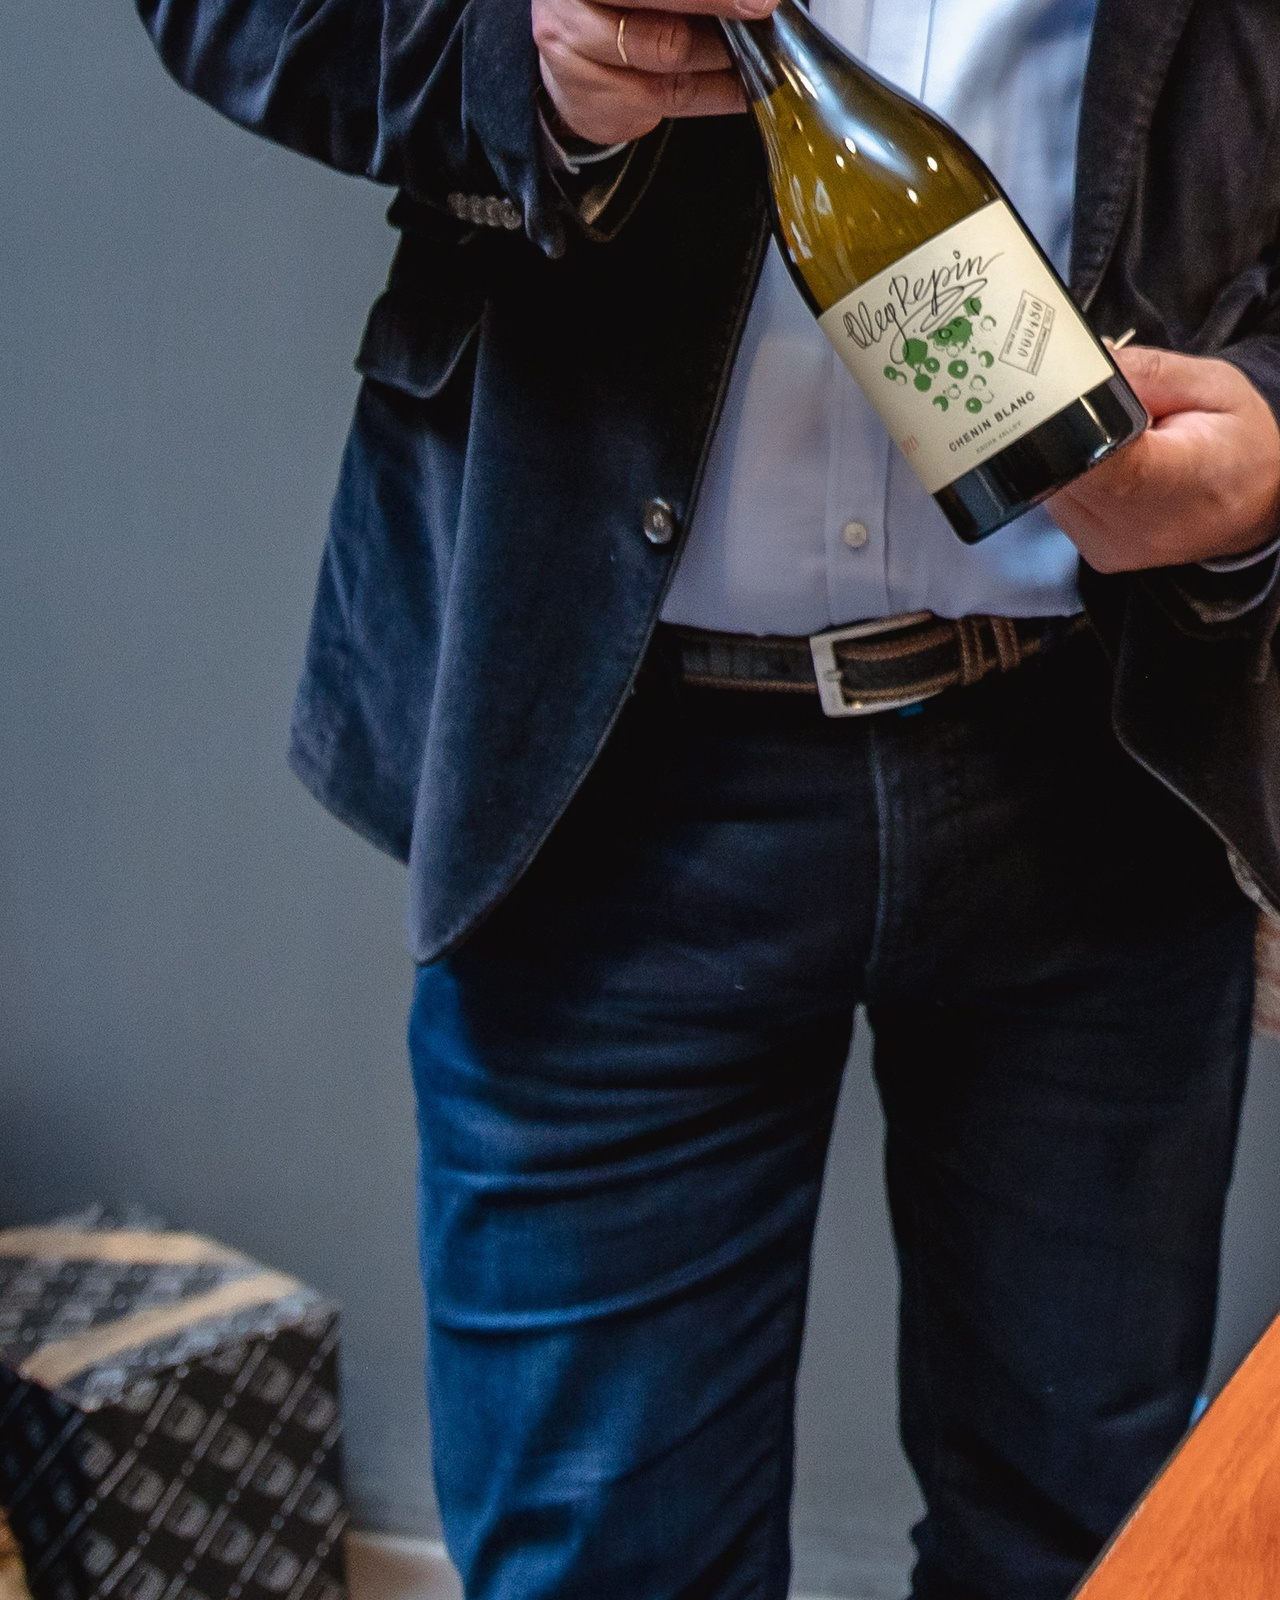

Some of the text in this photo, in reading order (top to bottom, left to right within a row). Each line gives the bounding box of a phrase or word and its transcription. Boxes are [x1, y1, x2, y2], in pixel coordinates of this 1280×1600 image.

[842, 250, 1005, 365] Oleg Repin
[949, 419, 992, 452] CHENIN
[994, 391, 1035, 423] BLANC
